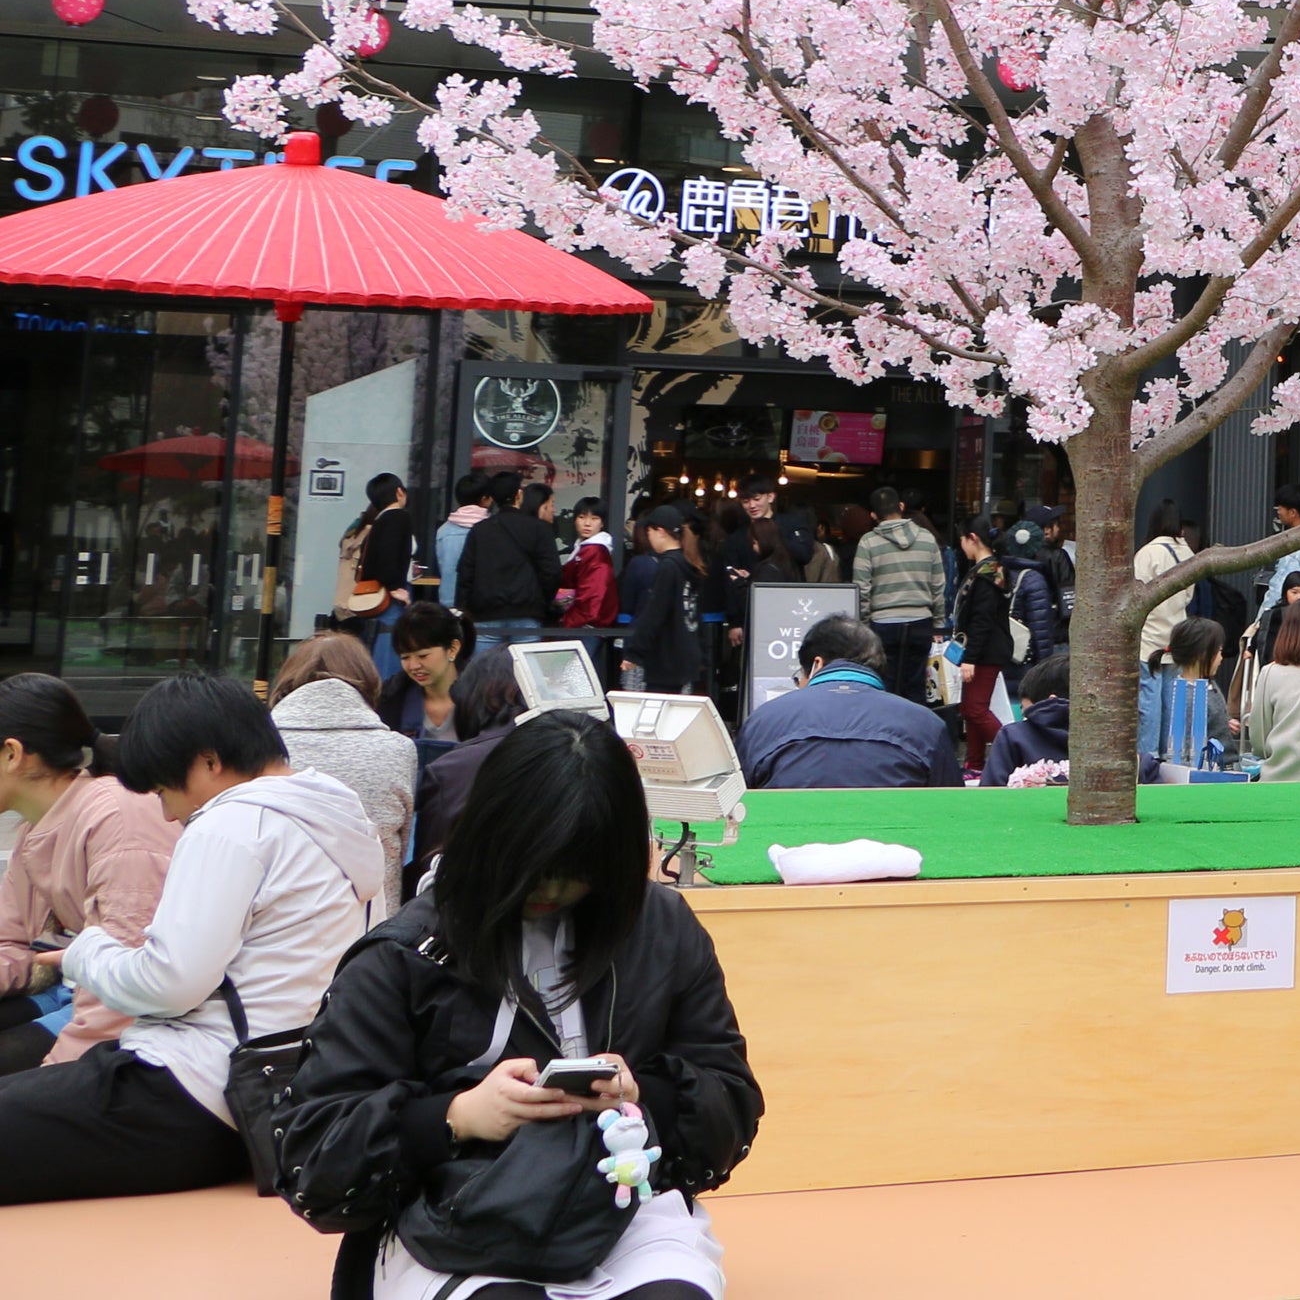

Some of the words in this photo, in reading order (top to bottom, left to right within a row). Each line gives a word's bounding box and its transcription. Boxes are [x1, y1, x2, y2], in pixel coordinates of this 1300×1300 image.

[14, 135, 417, 201] SKYT
[915, 385, 944, 404] ALLE
[779, 627, 801, 638] WE
[768, 640, 802, 660] OP
[1184, 950, 1278, 962] あぶないのでのぼらないで下さい
[1195, 964, 1220, 975] Danger.
[1223, 964, 1233, 973] Do
[1233, 963, 1245, 972] not
[1246, 962, 1266, 972] climb.
